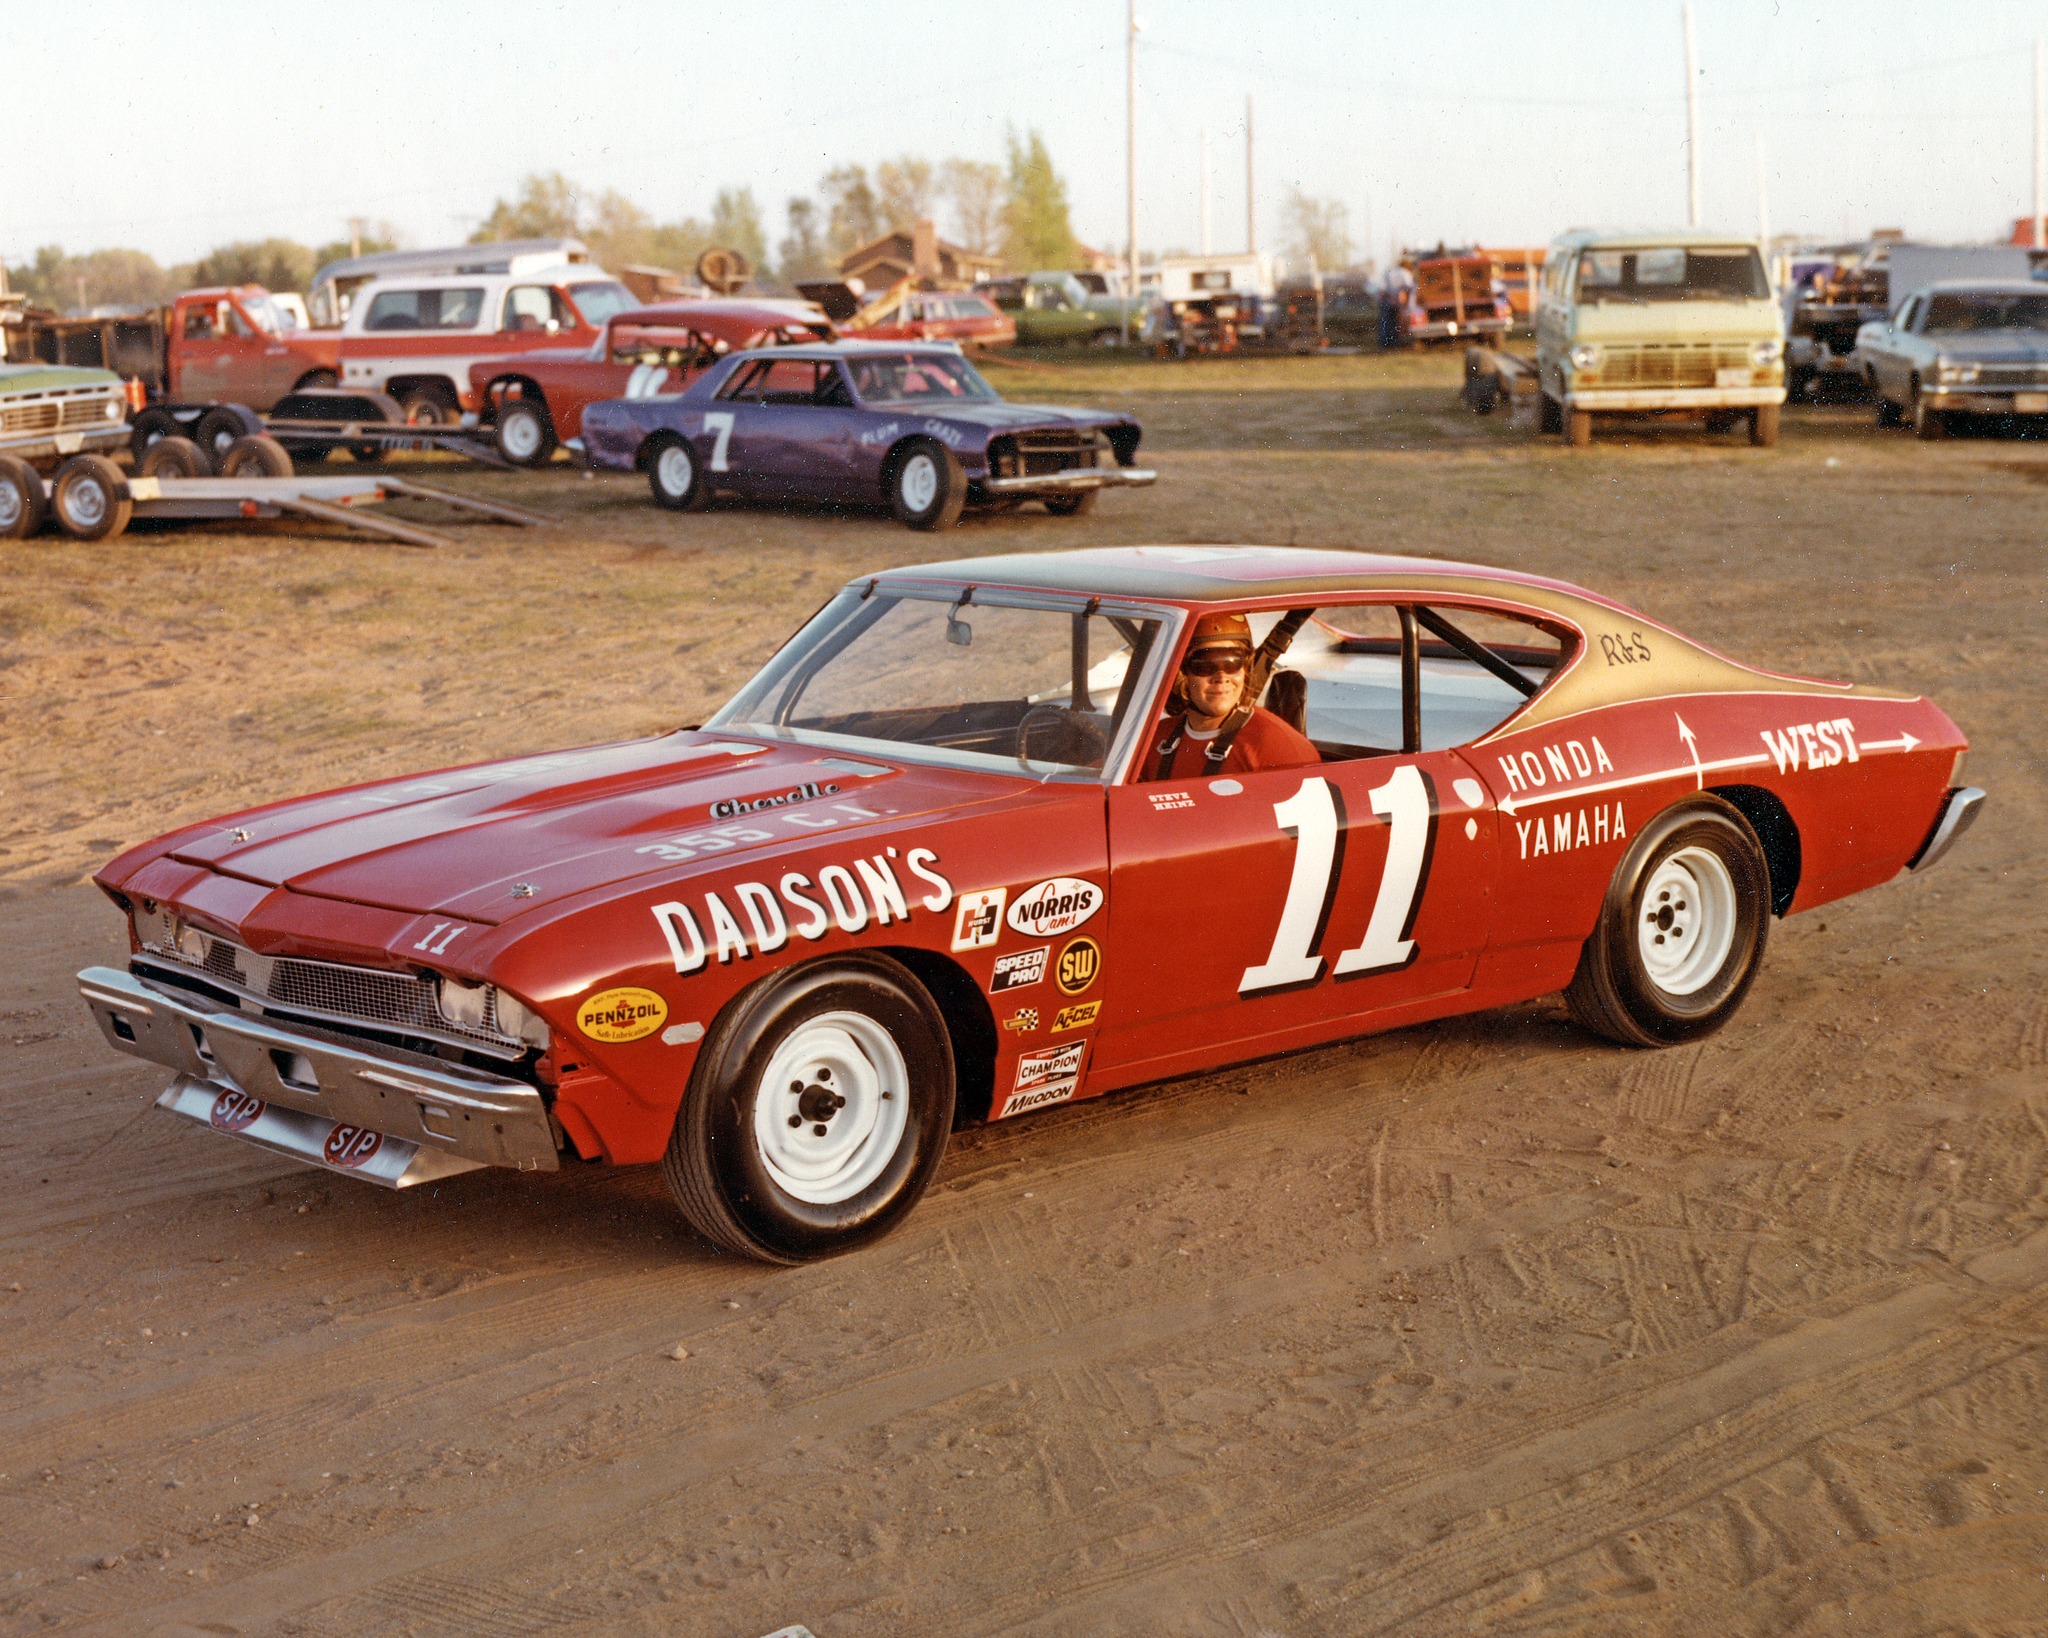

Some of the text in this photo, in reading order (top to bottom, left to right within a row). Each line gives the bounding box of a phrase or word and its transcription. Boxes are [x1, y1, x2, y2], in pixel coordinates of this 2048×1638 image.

[703, 411, 735, 472] 7
[1497, 735, 1614, 793] HONDA
[1760, 718, 1860, 776] WEST
[709, 781, 843, 820] Chevelle
[1147, 791, 1190, 803] STEVE
[1153, 799, 1196, 811] HEINZ
[634, 804, 899, 861] 355 C.I.
[1515, 801, 1627, 860] YAMAHA
[1237, 764, 1437, 998] 11
[651, 845, 955, 976] DADSON'S
[968, 916, 992, 928] HURST
[1017, 889, 1093, 925] NORRIS
[1034, 882, 1077, 934] Cams
[413, 921, 468, 956] 11
[995, 950, 1044, 975] SPEED
[1007, 965, 1040, 986] PRO
[1062, 949, 1094, 982] SW
[584, 1003, 661, 1027] PENNZOIL
[596, 1026, 650, 1039] Safe Lubrication
[1021, 1053, 1079, 1079] CHAMPION
